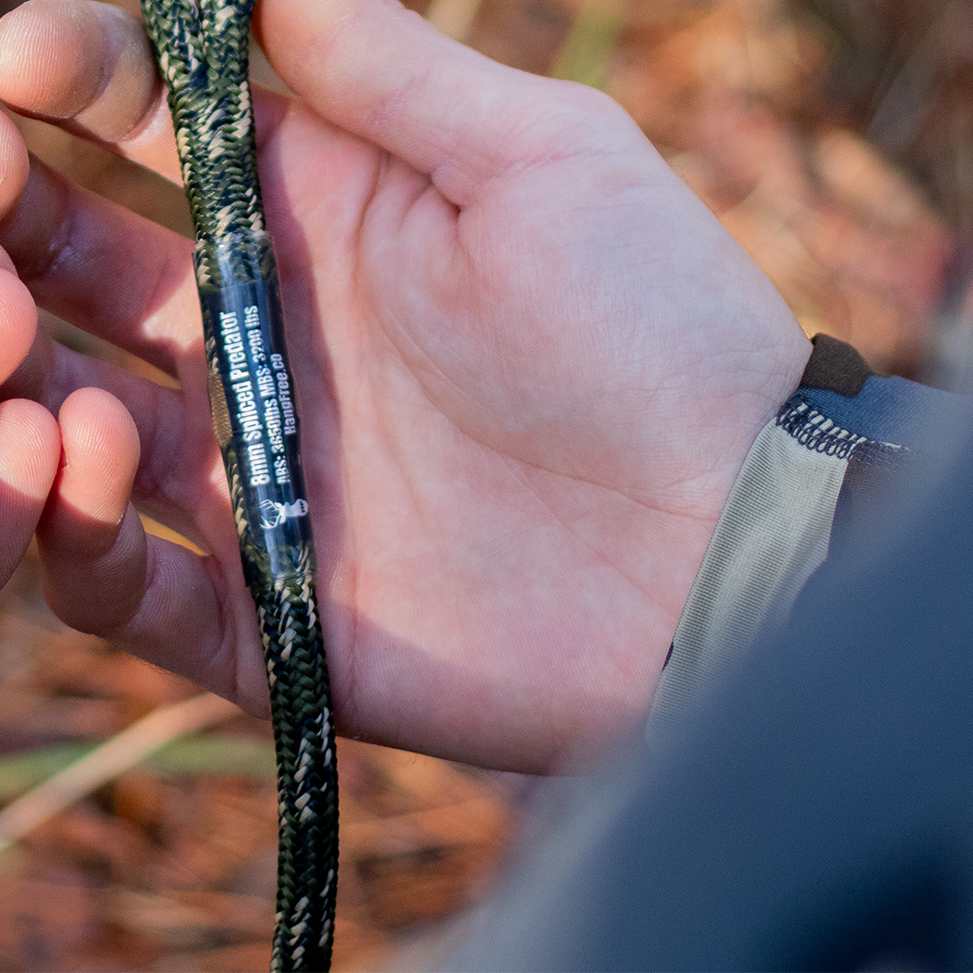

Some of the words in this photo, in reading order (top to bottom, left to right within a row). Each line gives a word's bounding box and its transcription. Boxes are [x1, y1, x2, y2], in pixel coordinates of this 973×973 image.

[244, 305, 260, 328] lbs
[219, 311, 250, 381] Predator
[248, 329, 267, 363] 3200
[256, 363, 276, 397] MBS:
[270, 353, 296, 435] HangFree.co
[232, 381, 263, 442] Spliced
[264, 398, 285, 454] 3650lbs
[249, 443, 270, 486] 8mm
[273, 455, 290, 484] ABS:
